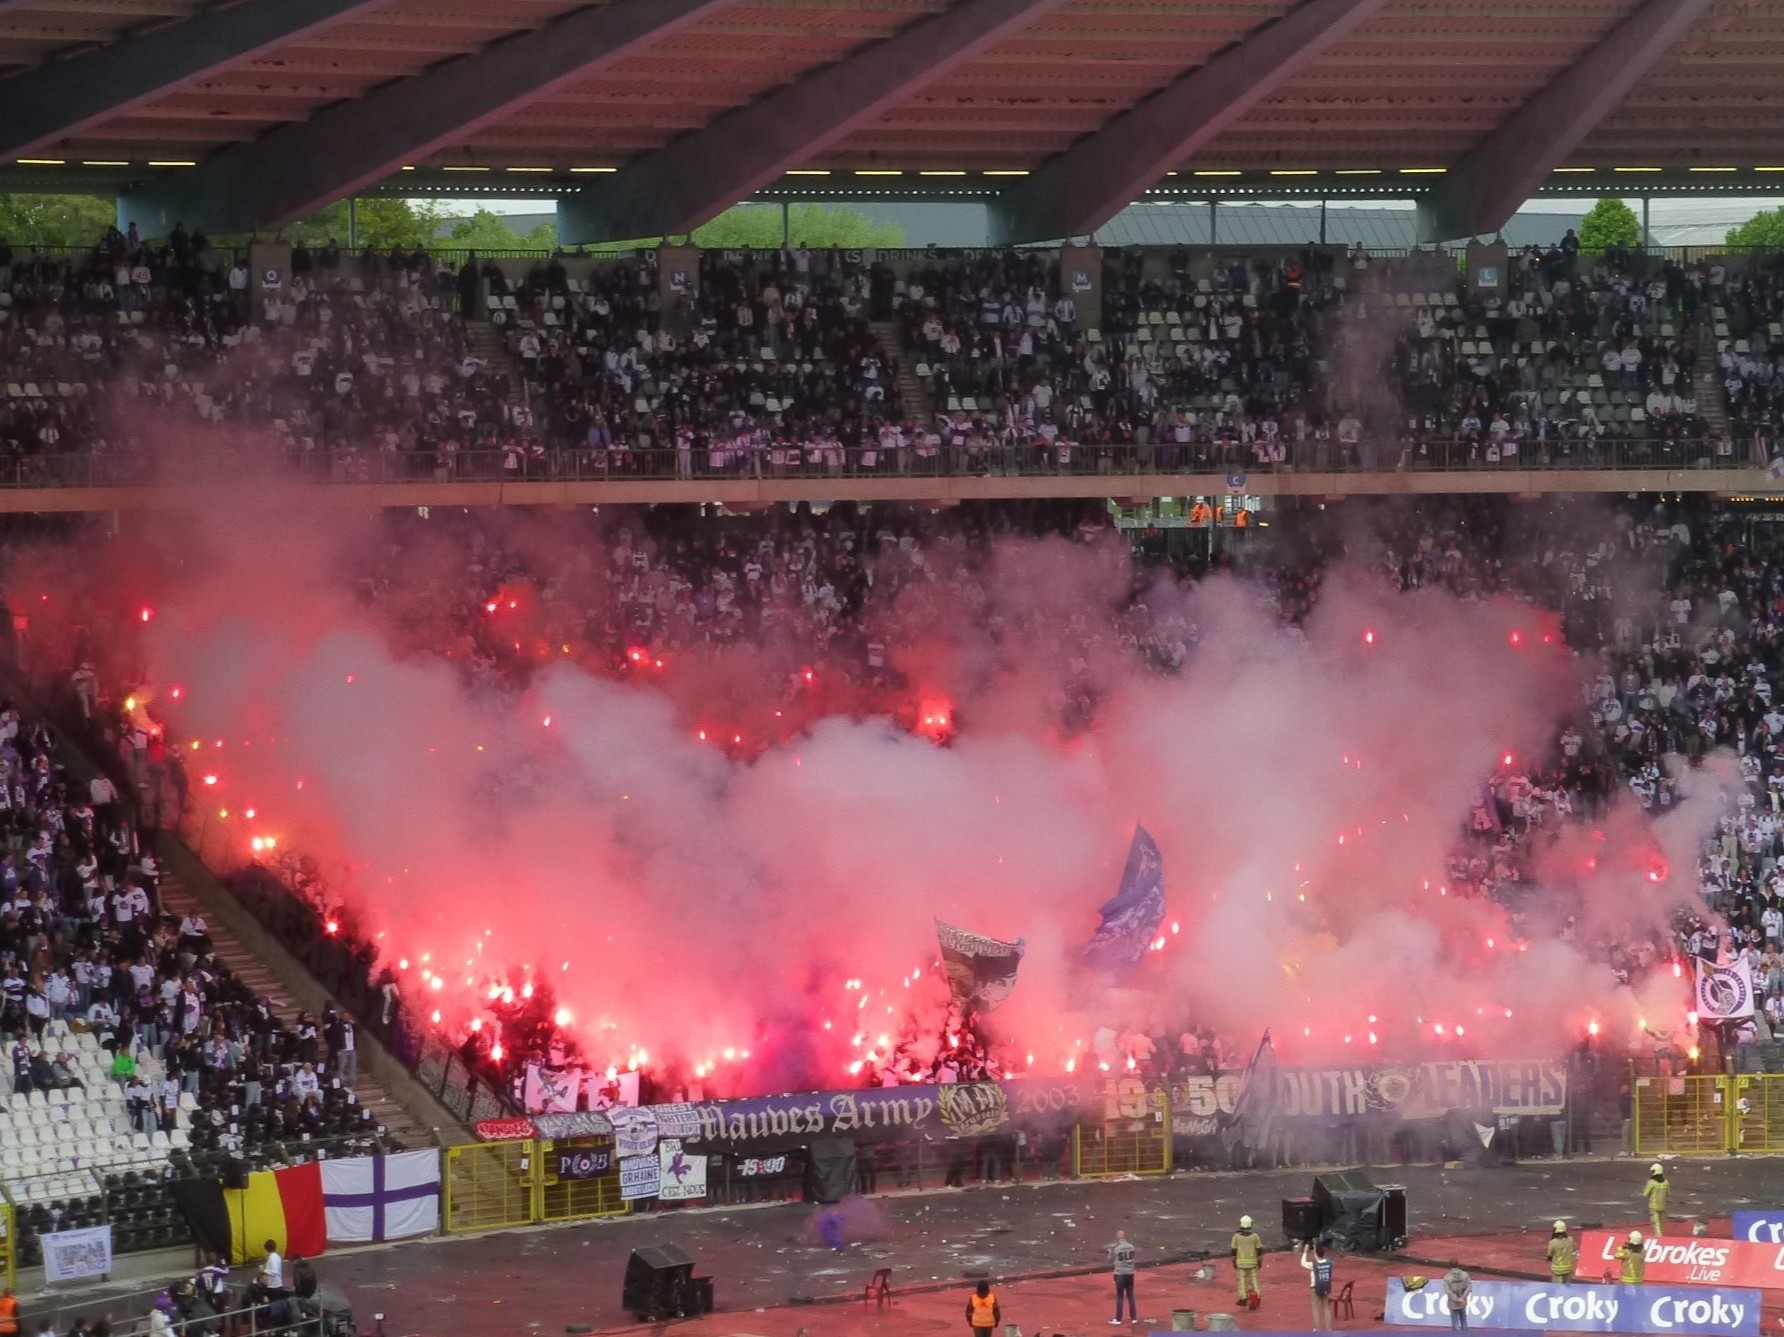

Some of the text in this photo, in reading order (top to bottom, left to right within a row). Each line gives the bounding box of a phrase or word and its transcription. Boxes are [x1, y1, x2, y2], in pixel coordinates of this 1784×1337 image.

[877, 249, 938, 261] DRINKS
[674, 272, 685, 282] N
[1076, 272, 1088, 283] M
[1232, 476, 1241, 485] C
[1014, 1083, 1081, 1115] 2003
[1420, 1063, 1563, 1109] LEADERS
[829, 1093, 933, 1133] Army
[1748, 1219, 1784, 1243] Cr
[1601, 1236, 1729, 1267] Lbrokes
[1525, 1290, 1619, 1324] Croky
[1650, 1294, 1745, 1328] Croky
